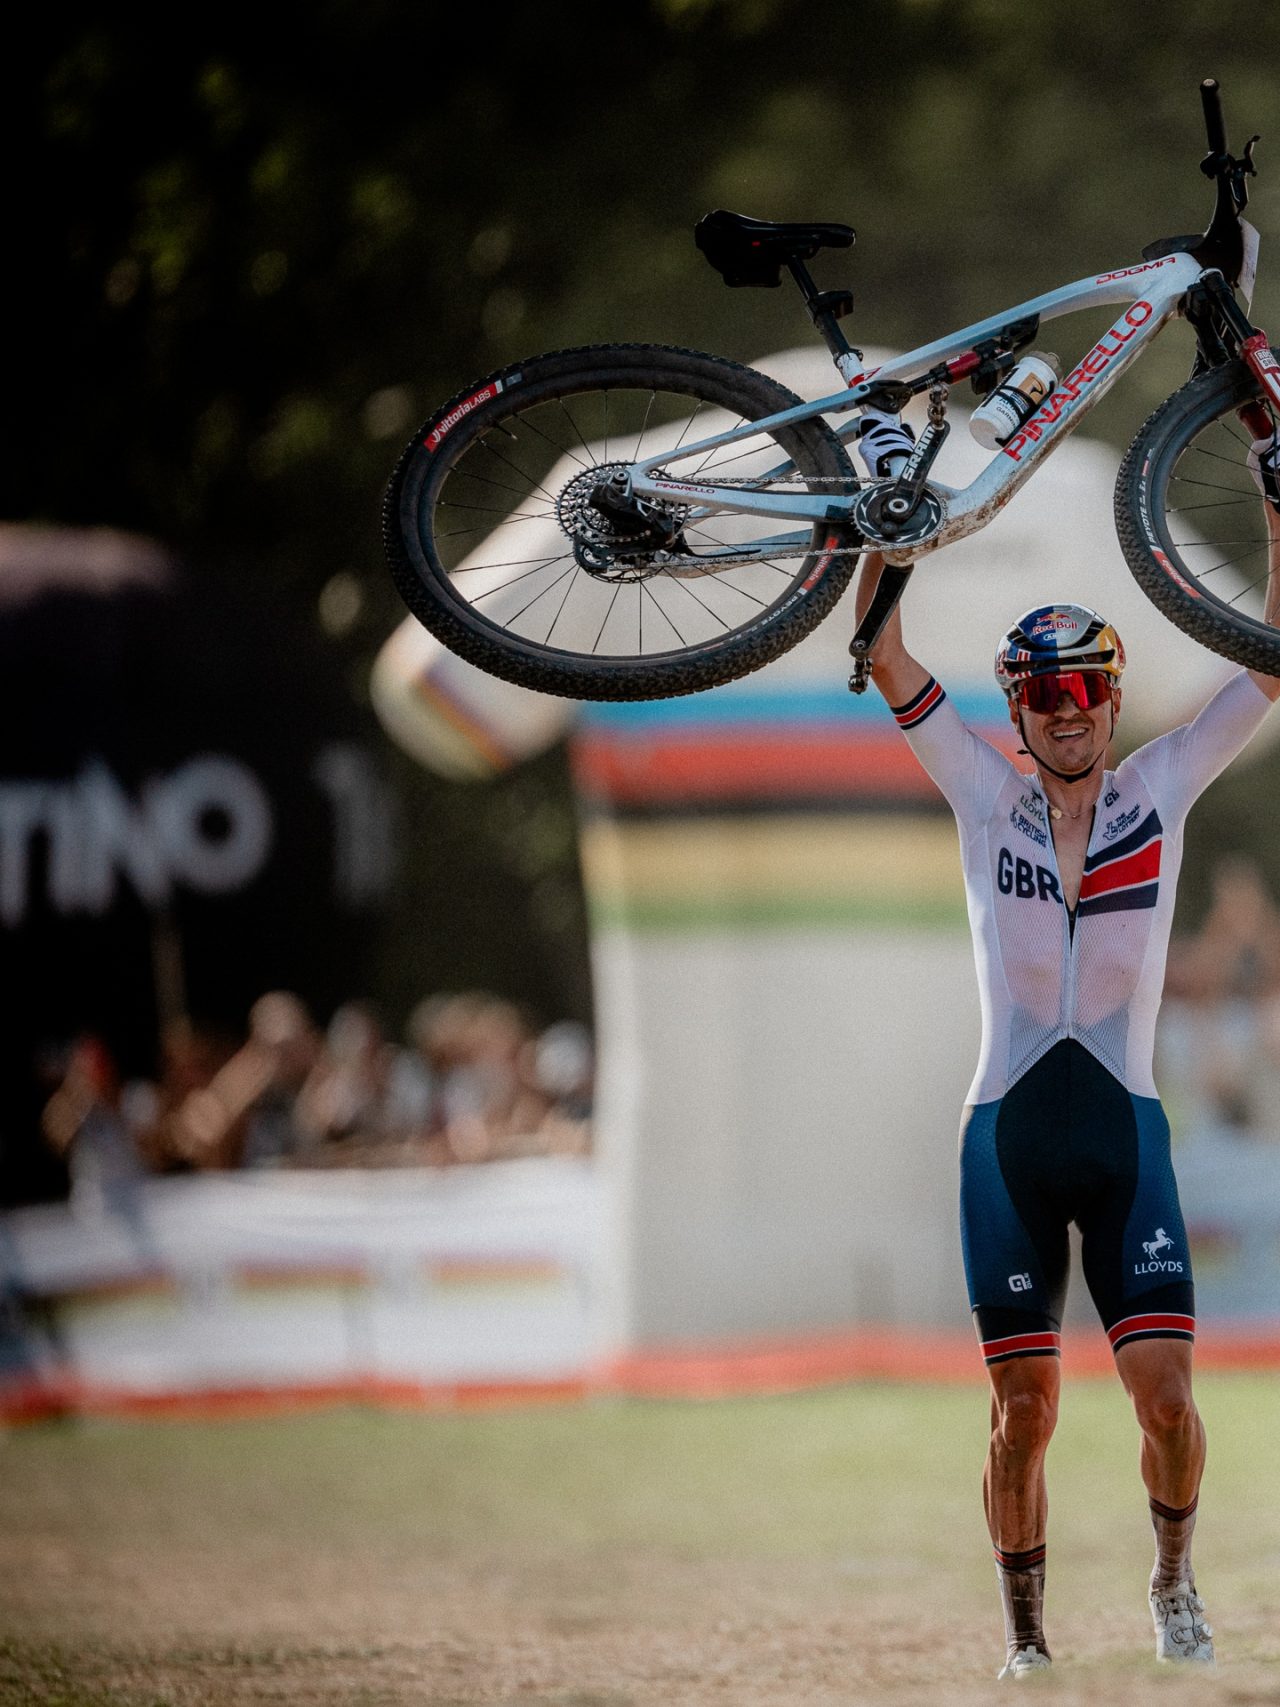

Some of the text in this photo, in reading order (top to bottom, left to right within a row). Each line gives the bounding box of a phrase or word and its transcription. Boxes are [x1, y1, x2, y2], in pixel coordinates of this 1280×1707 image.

[1096, 256, 1176, 285] DOGMA
[1002, 300, 1153, 462] PINARELLO
[902, 426, 937, 481] SRAM
[655, 482, 715, 494] PINARELLO
[1032, 621, 1078, 635] Red Bull
[1017, 822, 1047, 848] CYCLING
[1019, 814, 1047, 840] BRITISH
[997, 847, 1063, 904] GBR
[1134, 1261, 1183, 1275] LLOYDS
